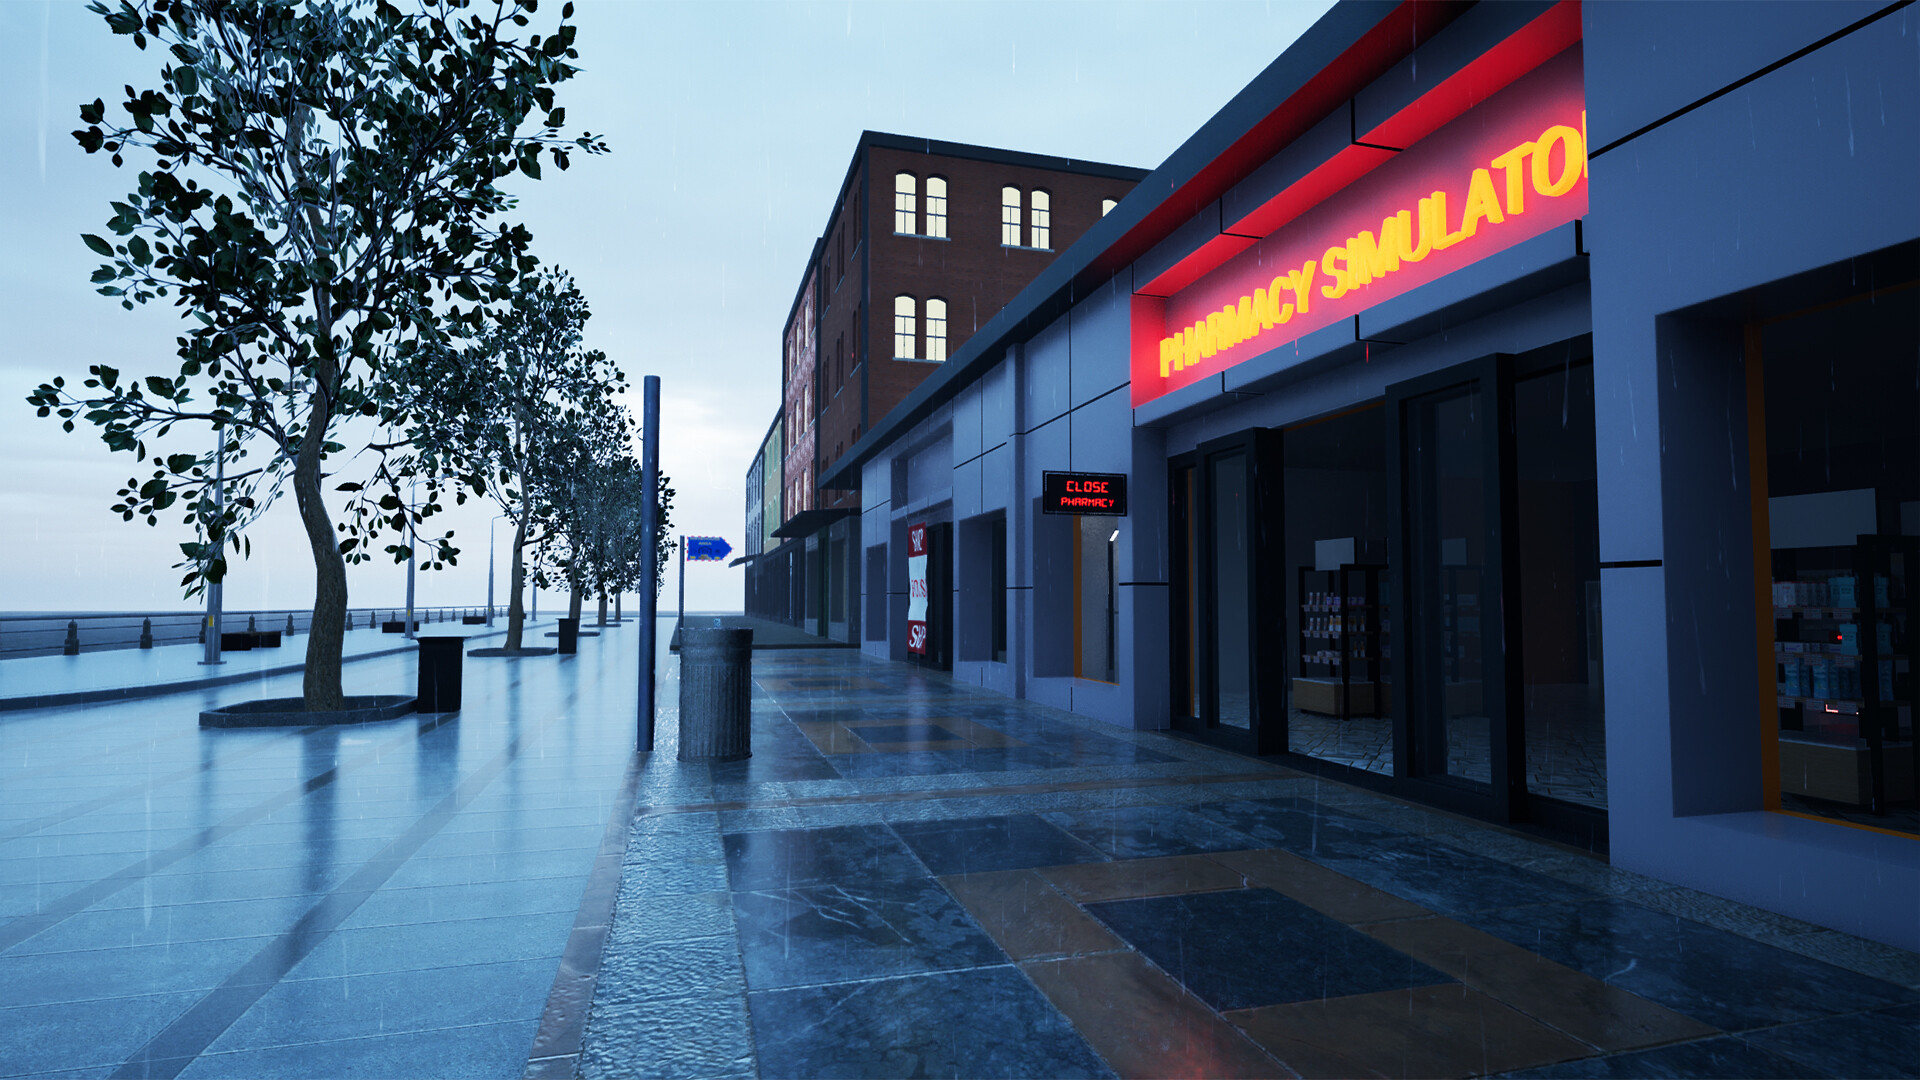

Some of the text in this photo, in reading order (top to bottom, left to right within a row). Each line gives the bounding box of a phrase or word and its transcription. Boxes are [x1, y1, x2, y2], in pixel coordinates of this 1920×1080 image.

[1160, 110, 1588, 377] PHARMACY SIMULATO
[1066, 480, 1109, 493] CLOSE
[1060, 497, 1114, 508] PHARMACY
